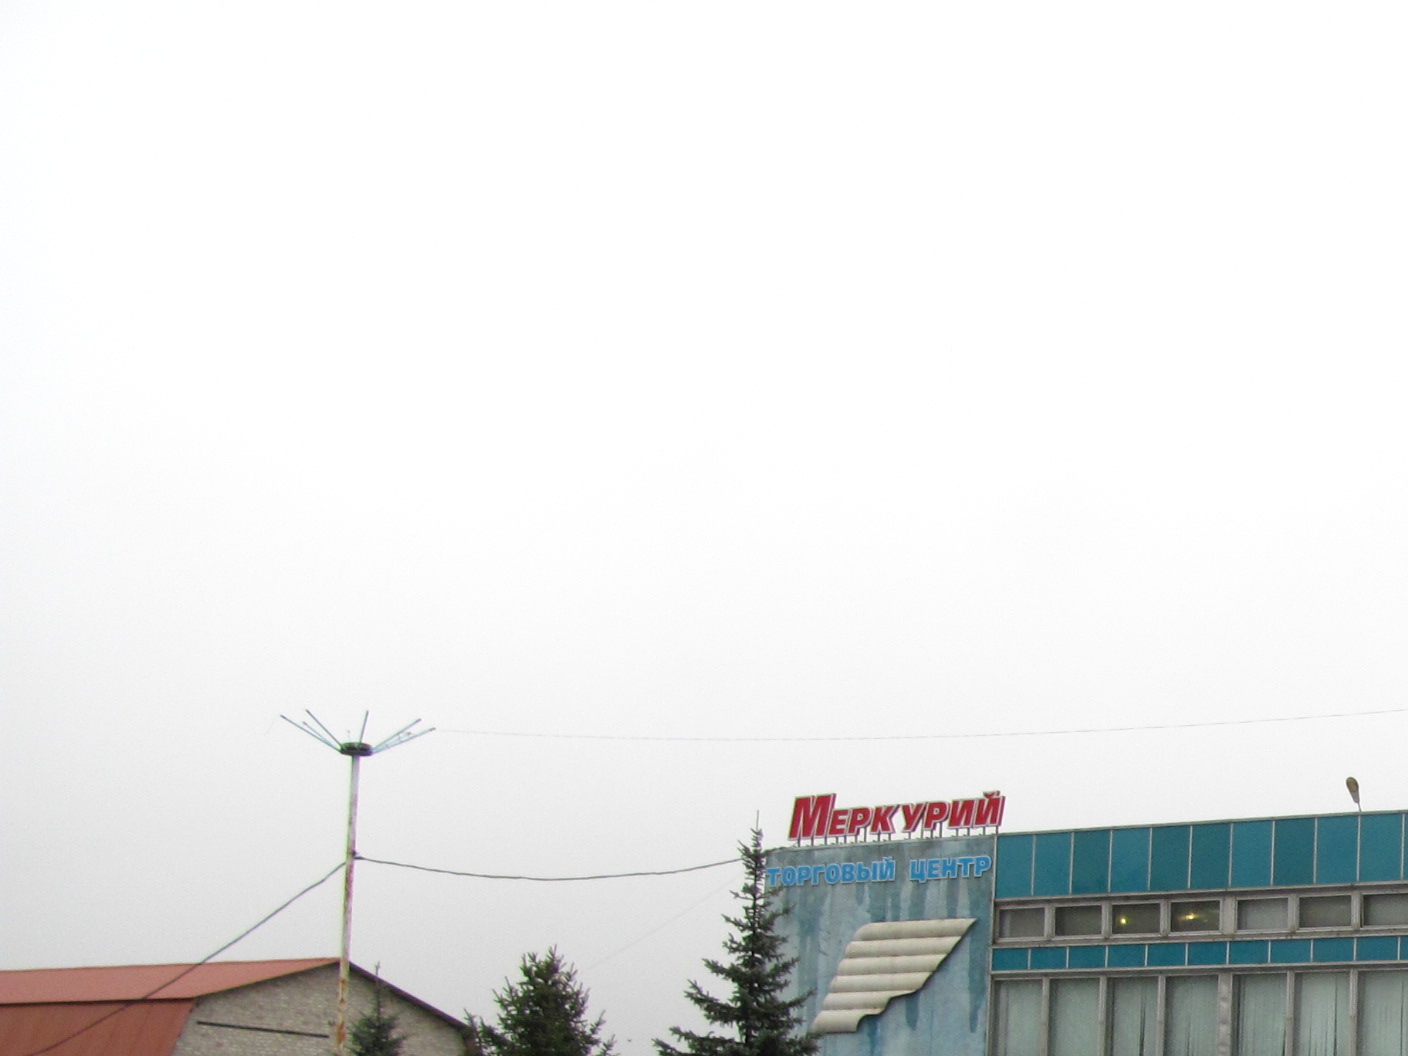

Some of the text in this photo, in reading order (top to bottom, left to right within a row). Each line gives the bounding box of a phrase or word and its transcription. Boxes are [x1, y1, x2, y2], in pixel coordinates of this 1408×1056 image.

[788, 790, 1006, 841] МЕРКУРИЙ
[766, 855, 992, 887] ТОРГОВЫЙ ЦЕНТР
